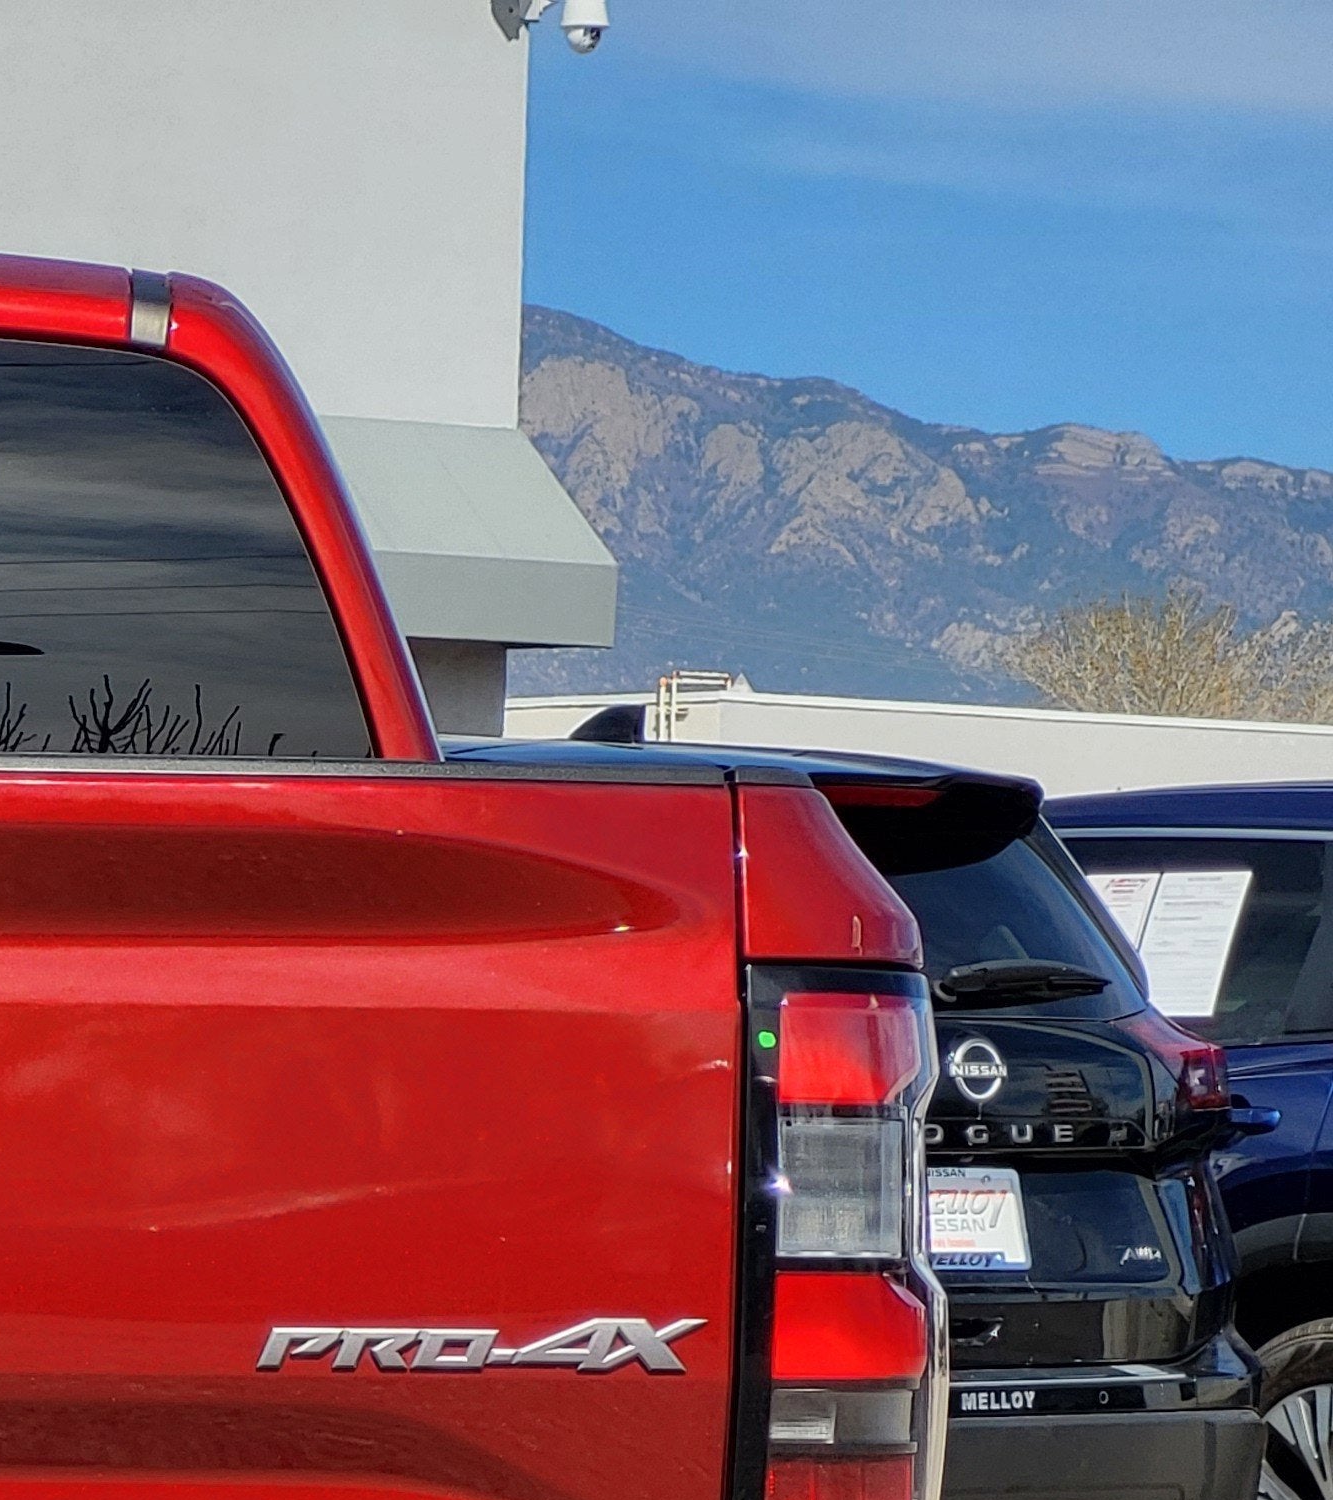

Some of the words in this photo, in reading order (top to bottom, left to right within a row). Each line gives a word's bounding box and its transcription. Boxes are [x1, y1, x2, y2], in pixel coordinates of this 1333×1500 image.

[950, 1064, 1008, 1077] NISSAN
[925, 1123, 1074, 1144] OGUE
[930, 1189, 1008, 1228] ELLOY
[255, 1317, 709, 1373] PRO-4X
[961, 1391, 1035, 1411] MELLOY
